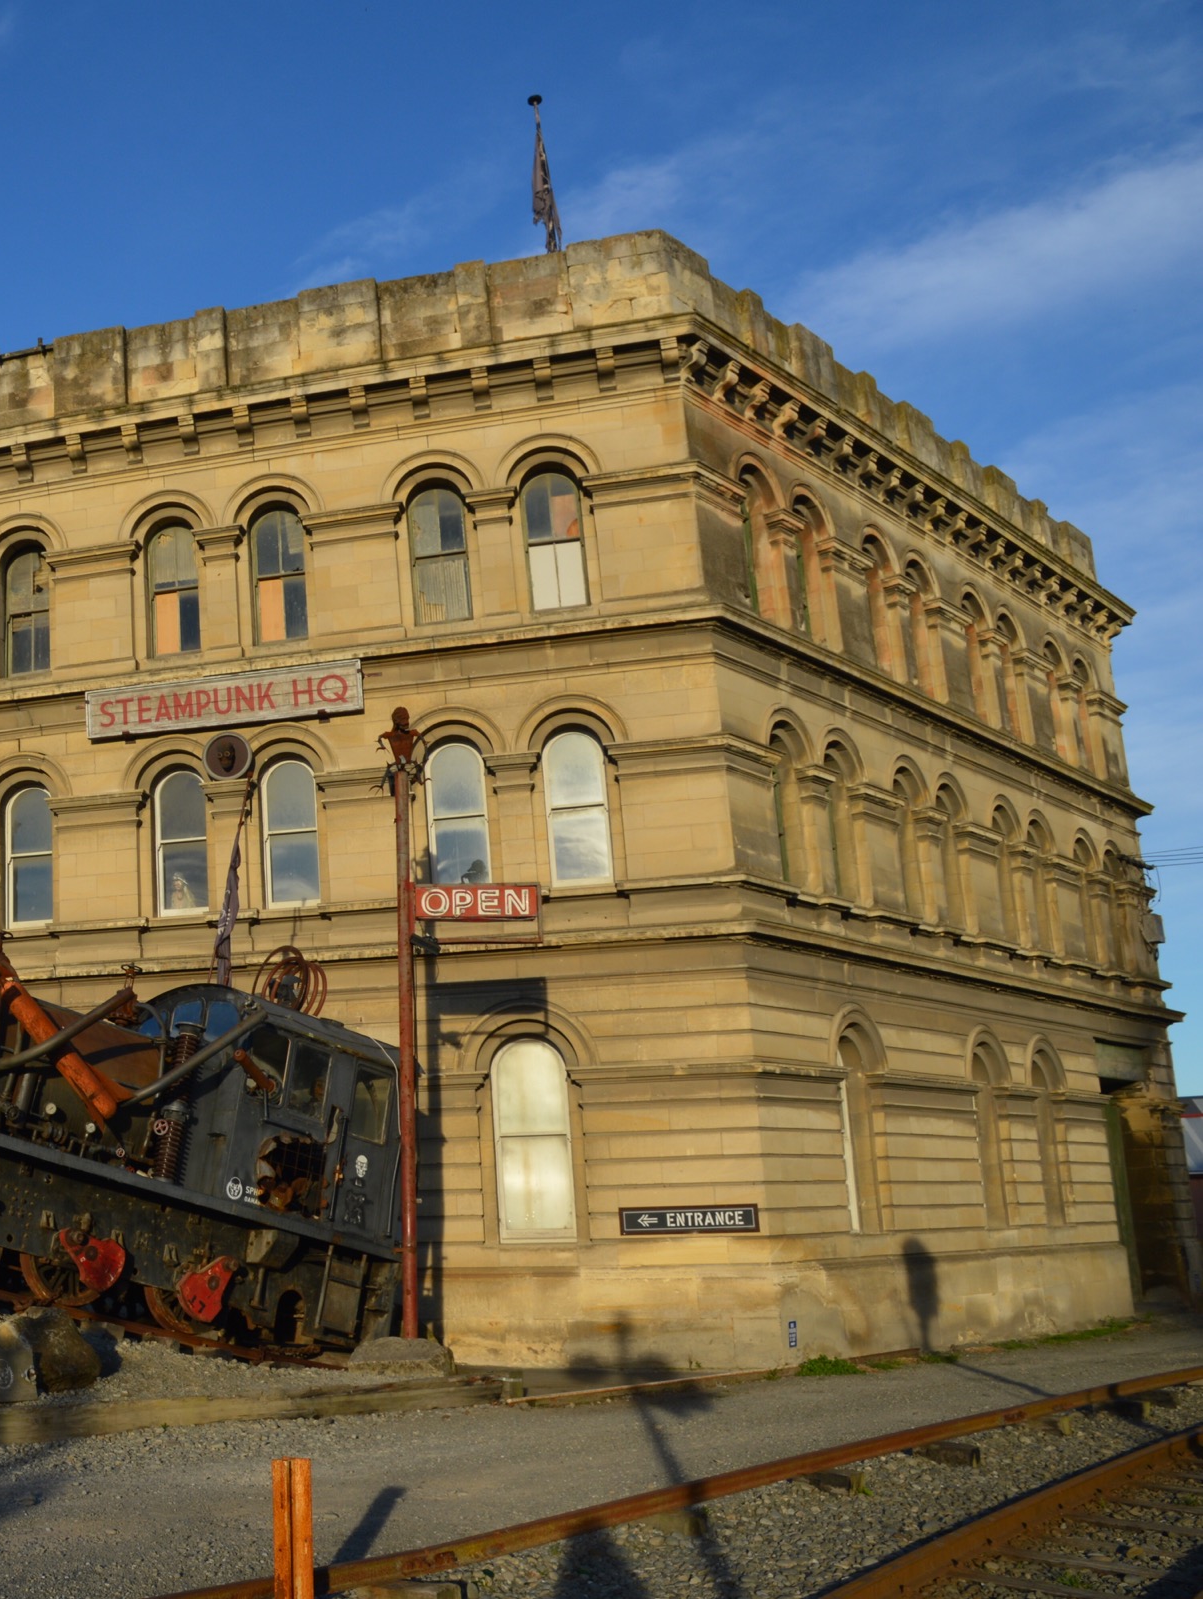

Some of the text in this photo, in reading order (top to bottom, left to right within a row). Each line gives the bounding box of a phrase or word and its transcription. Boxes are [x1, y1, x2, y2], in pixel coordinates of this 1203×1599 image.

[100, 674, 349, 728] STEAMPUNK HQ
[421, 888, 530, 917] OPEN
[666, 1210, 745, 1227] ENTRANCE
